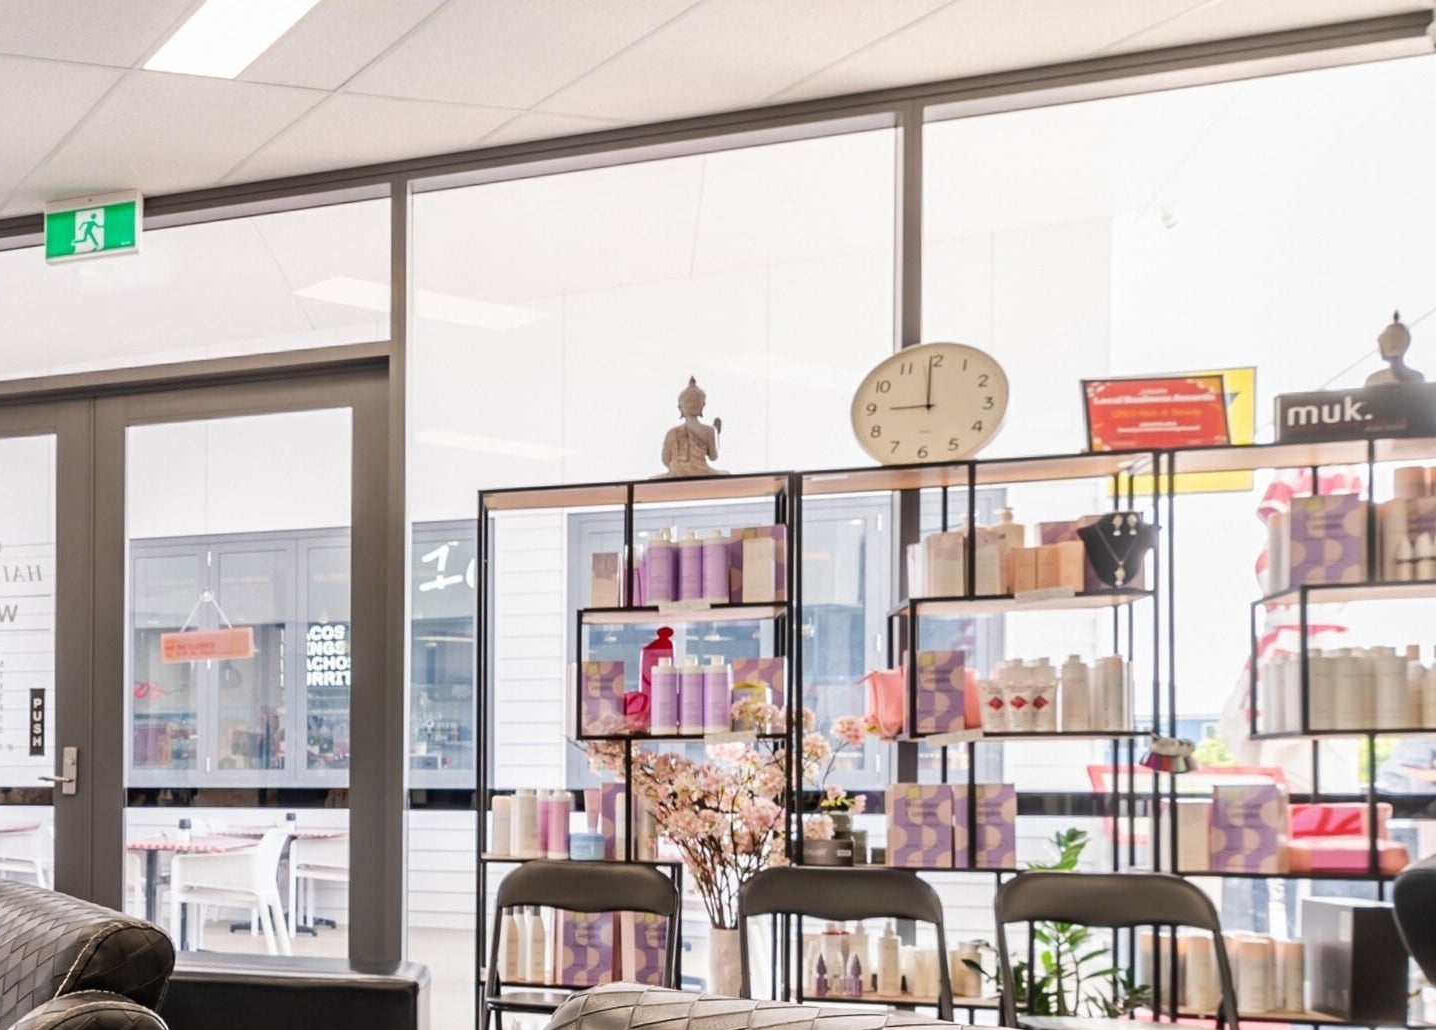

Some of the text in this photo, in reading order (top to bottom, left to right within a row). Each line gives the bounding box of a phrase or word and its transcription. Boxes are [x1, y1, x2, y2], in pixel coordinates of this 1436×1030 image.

[899, 362, 913, 375] 11
[962, 358, 967, 371] 1
[875, 380, 891, 393] 10
[977, 374, 989, 387] 2
[866, 403, 877, 416] 9
[982, 396, 994, 410] 3
[1287, 395, 1374, 426] muk.
[870, 425, 881, 438] 8
[971, 420, 982, 433] 4
[890, 441, 900, 454] 7
[947, 438, 959, 451] 5
[917, 446, 928, 458] 6
[32, 698, 42, 747] PUSH
